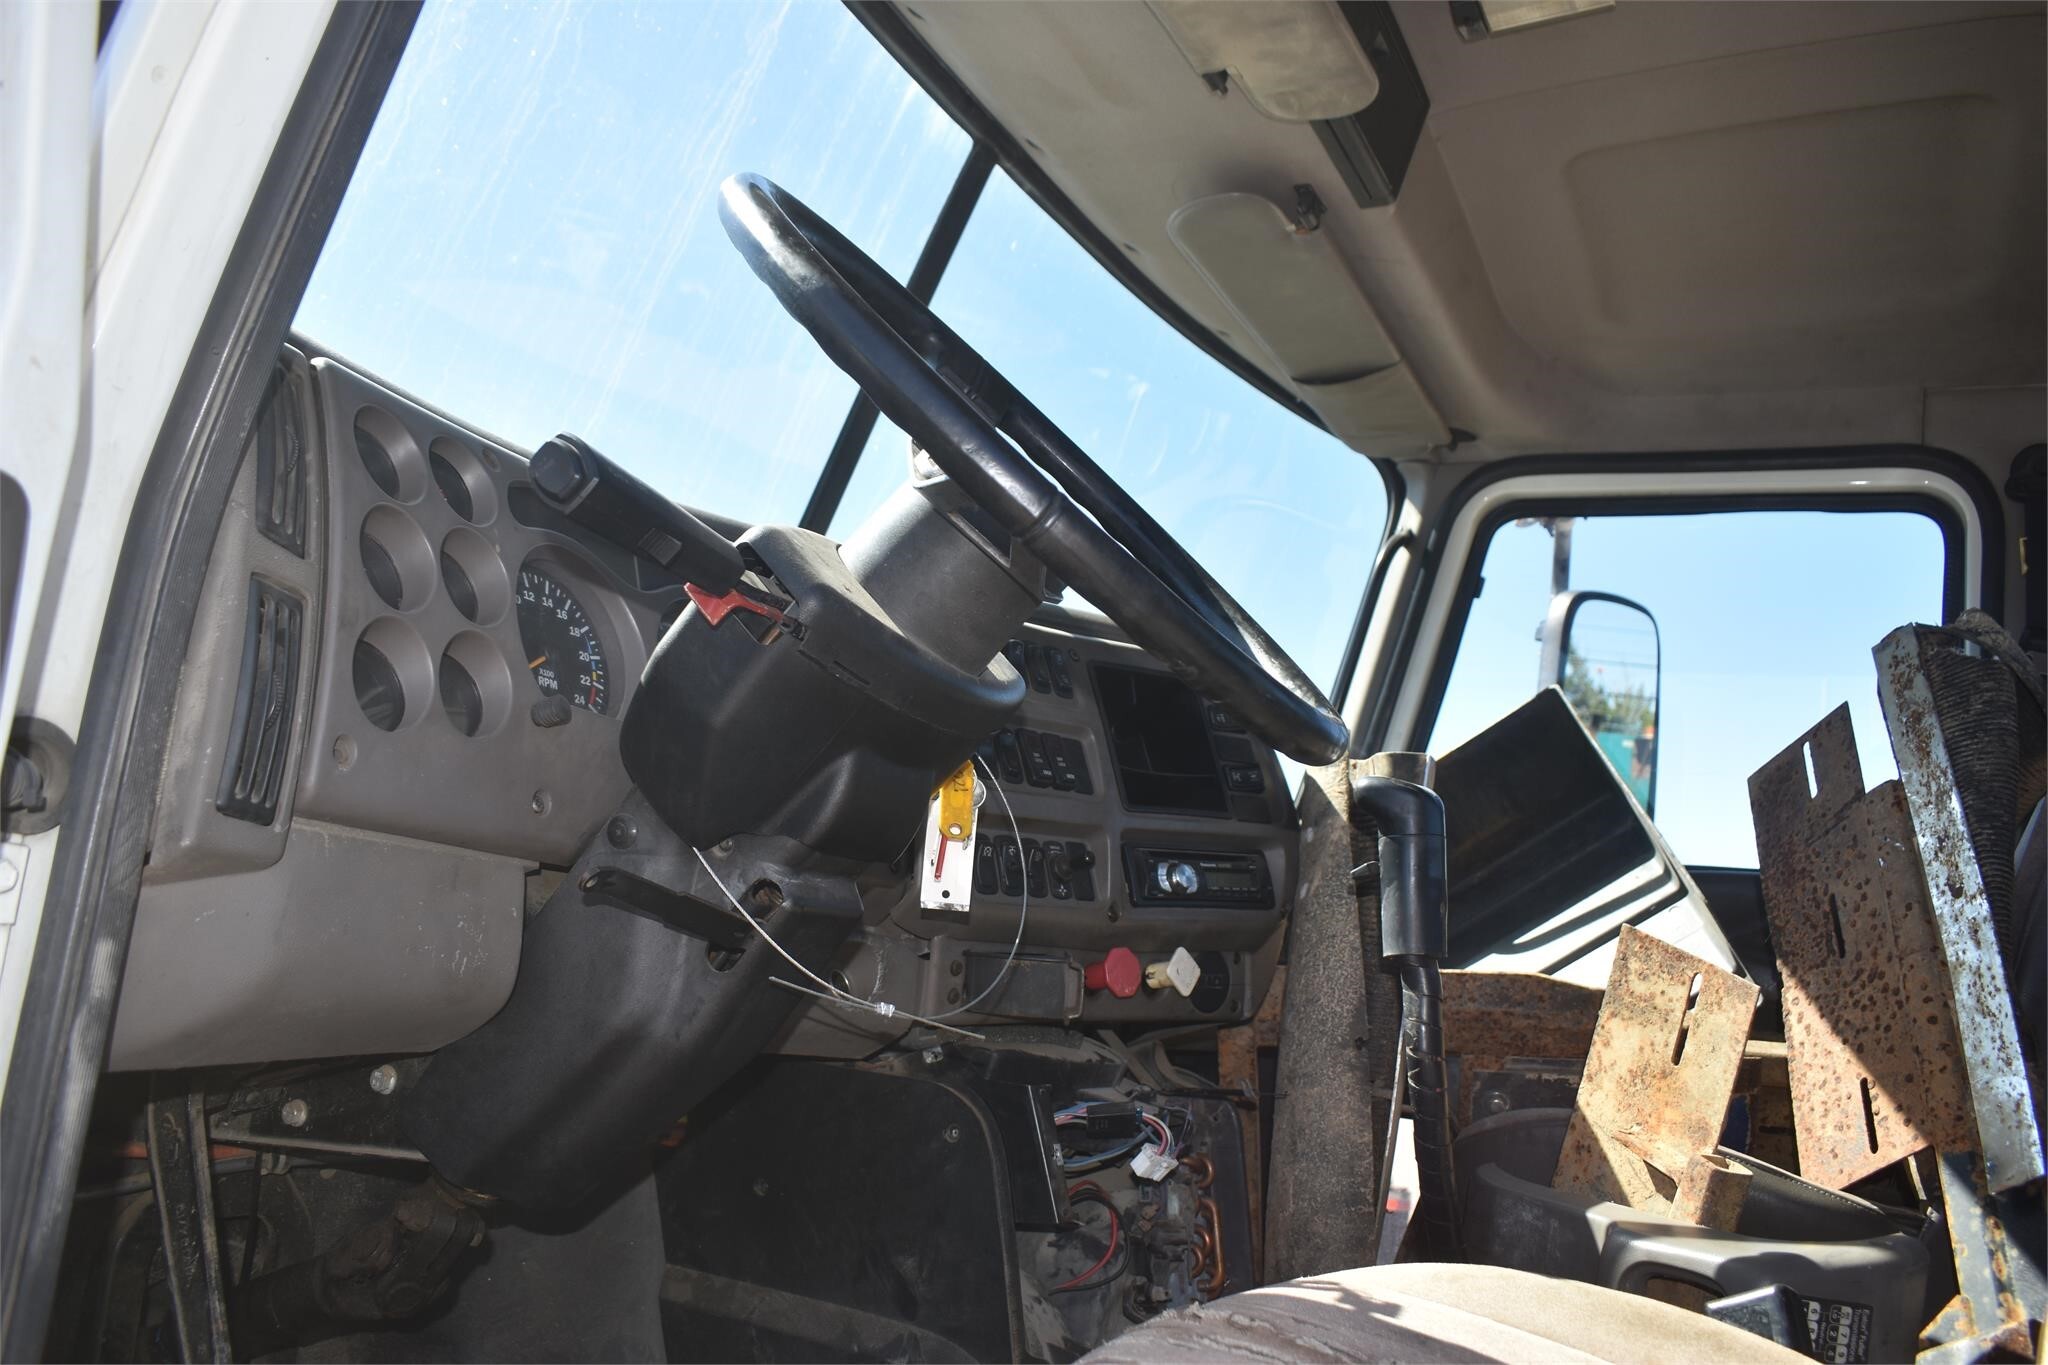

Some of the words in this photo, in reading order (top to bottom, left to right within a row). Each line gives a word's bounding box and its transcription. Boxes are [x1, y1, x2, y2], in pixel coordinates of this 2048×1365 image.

[523, 590, 535, 602] 12
[542, 597, 553, 608] 14
[556, 609, 568, 620] 16
[569, 626, 581, 637] 18
[579, 651, 590, 662] 20
[538, 676, 558, 690] RPM
[580, 675, 591, 686] 22
[574, 694, 585, 705] 24
